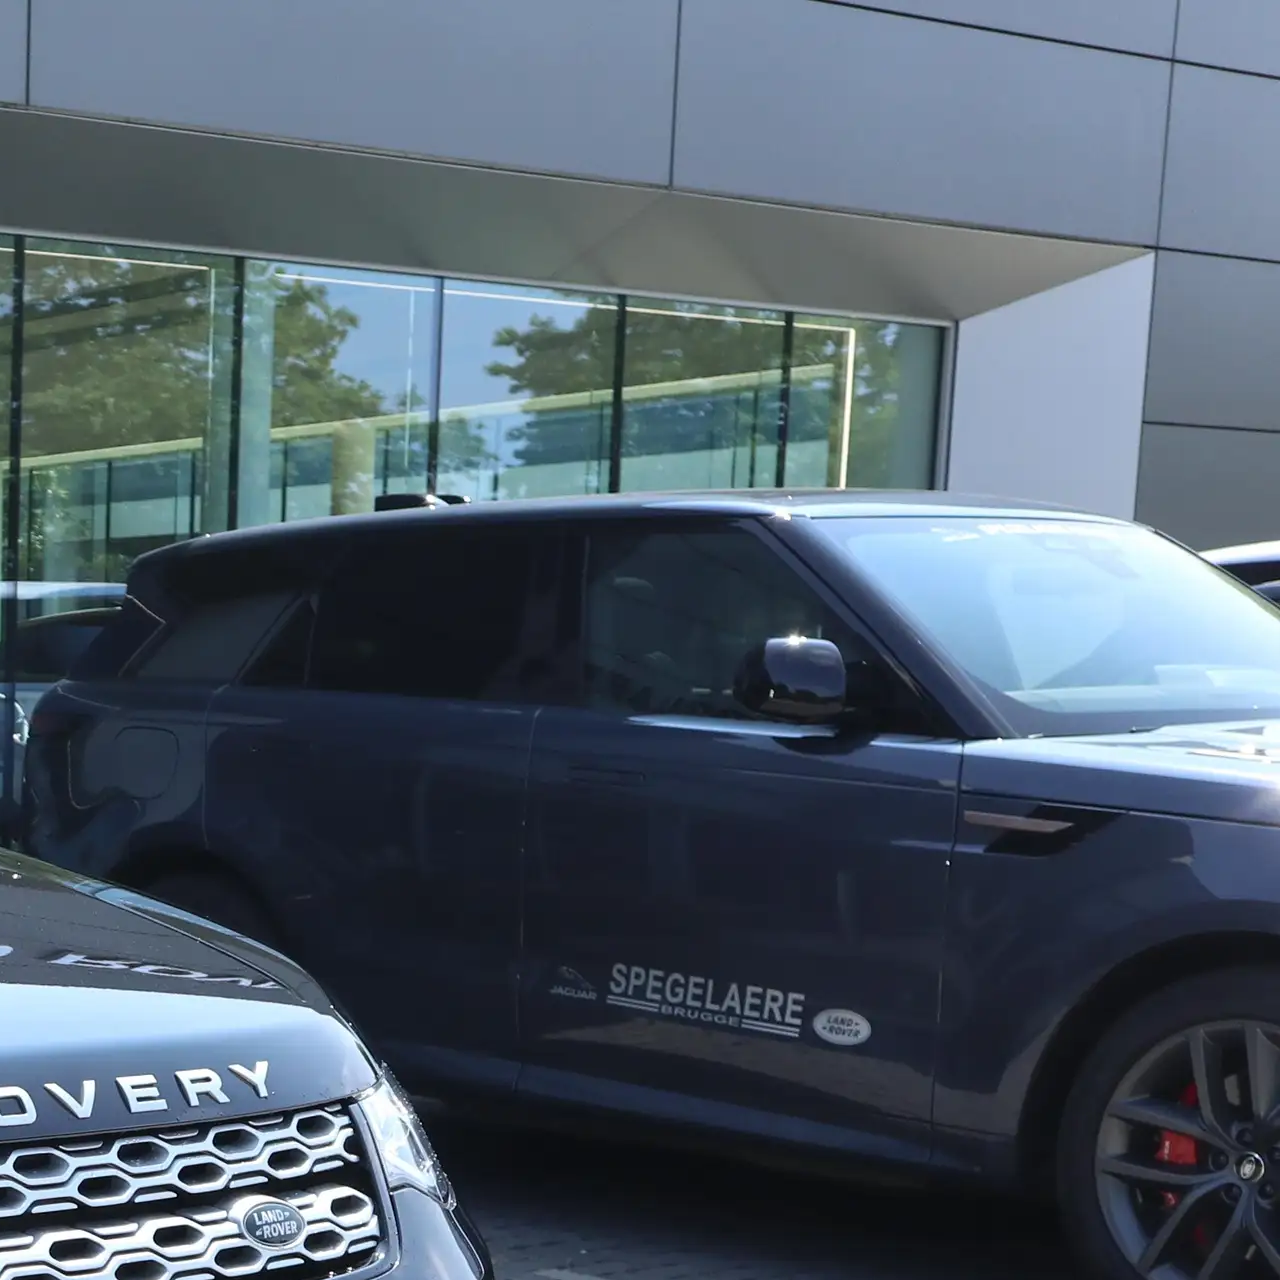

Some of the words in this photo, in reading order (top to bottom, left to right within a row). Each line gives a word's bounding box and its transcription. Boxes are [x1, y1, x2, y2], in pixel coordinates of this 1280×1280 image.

[549, 985, 598, 1000] JAGUAR
[609, 962, 806, 1026] SPEGELAERE
[661, 1004, 741, 1028] BRUGGE
[253, 1209, 285, 1226] LAND
[262, 1220, 299, 1239] ROVER
